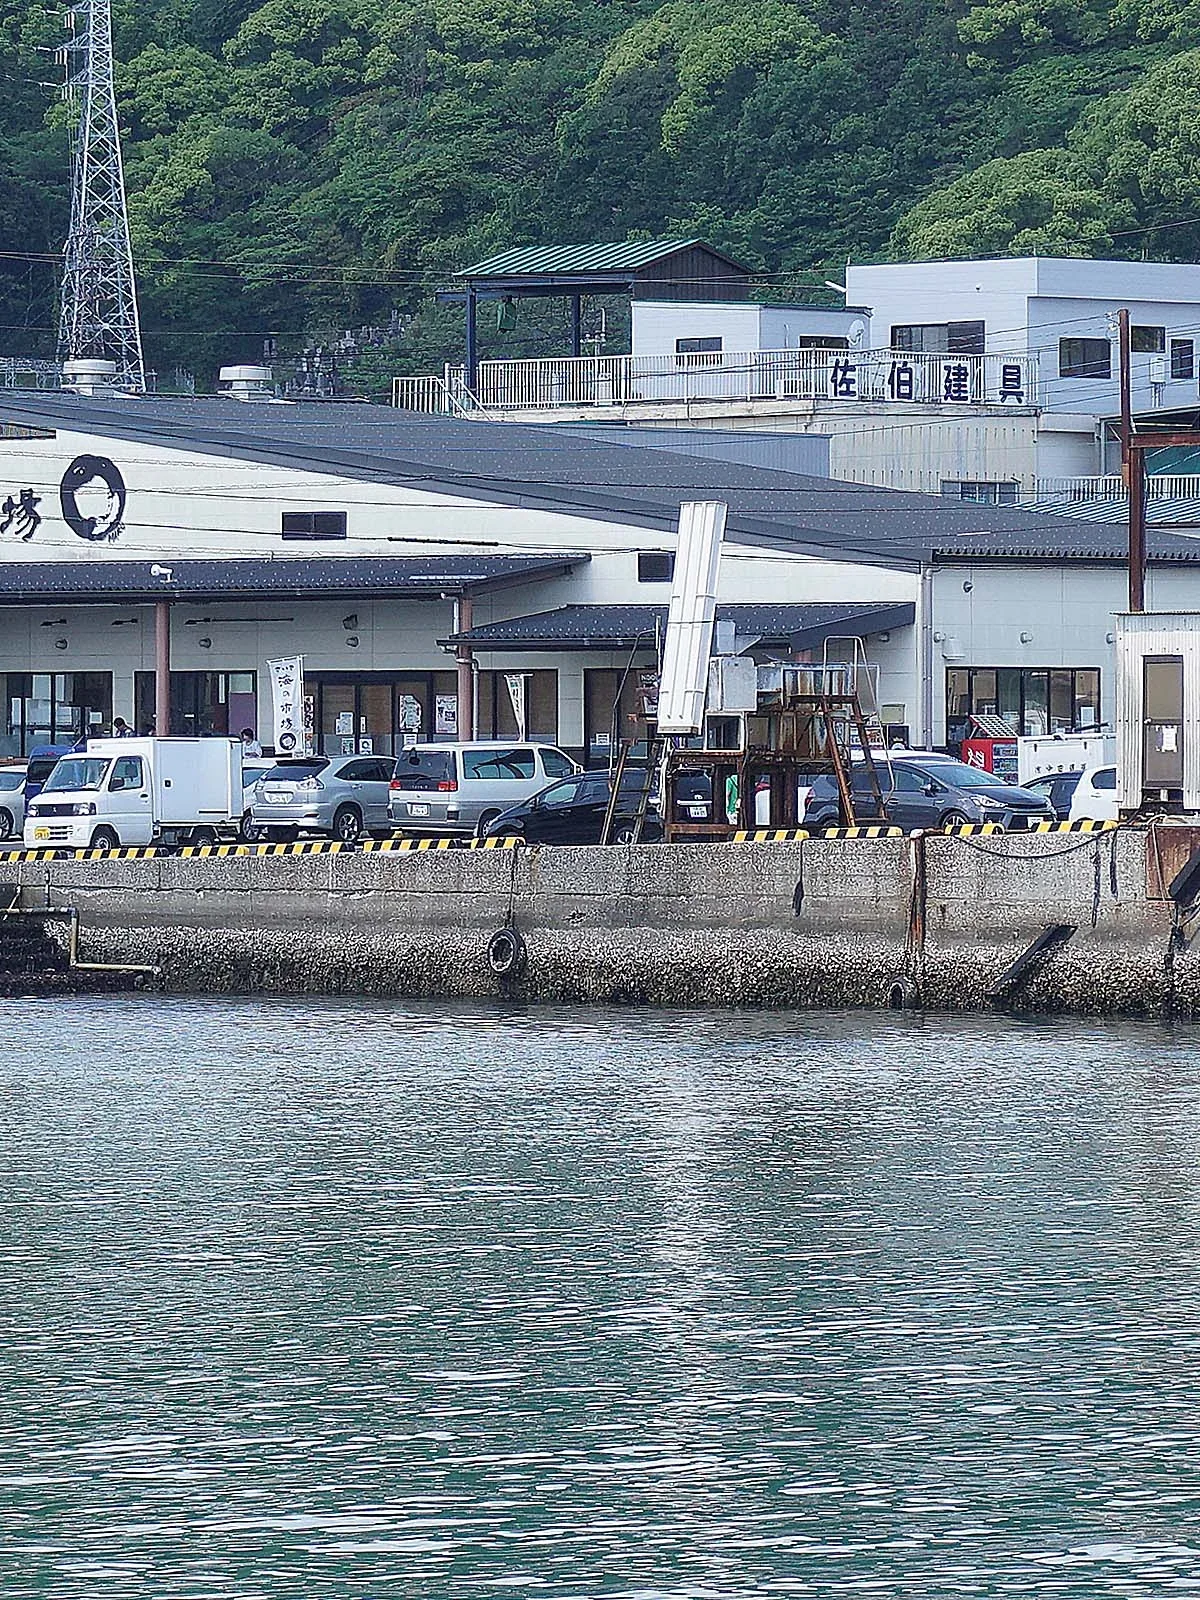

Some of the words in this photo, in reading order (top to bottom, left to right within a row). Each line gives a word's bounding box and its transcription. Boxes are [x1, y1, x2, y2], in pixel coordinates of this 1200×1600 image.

[830, 358, 1025, 404] 佐伯建具
[278, 674, 294, 730] 海の市場
